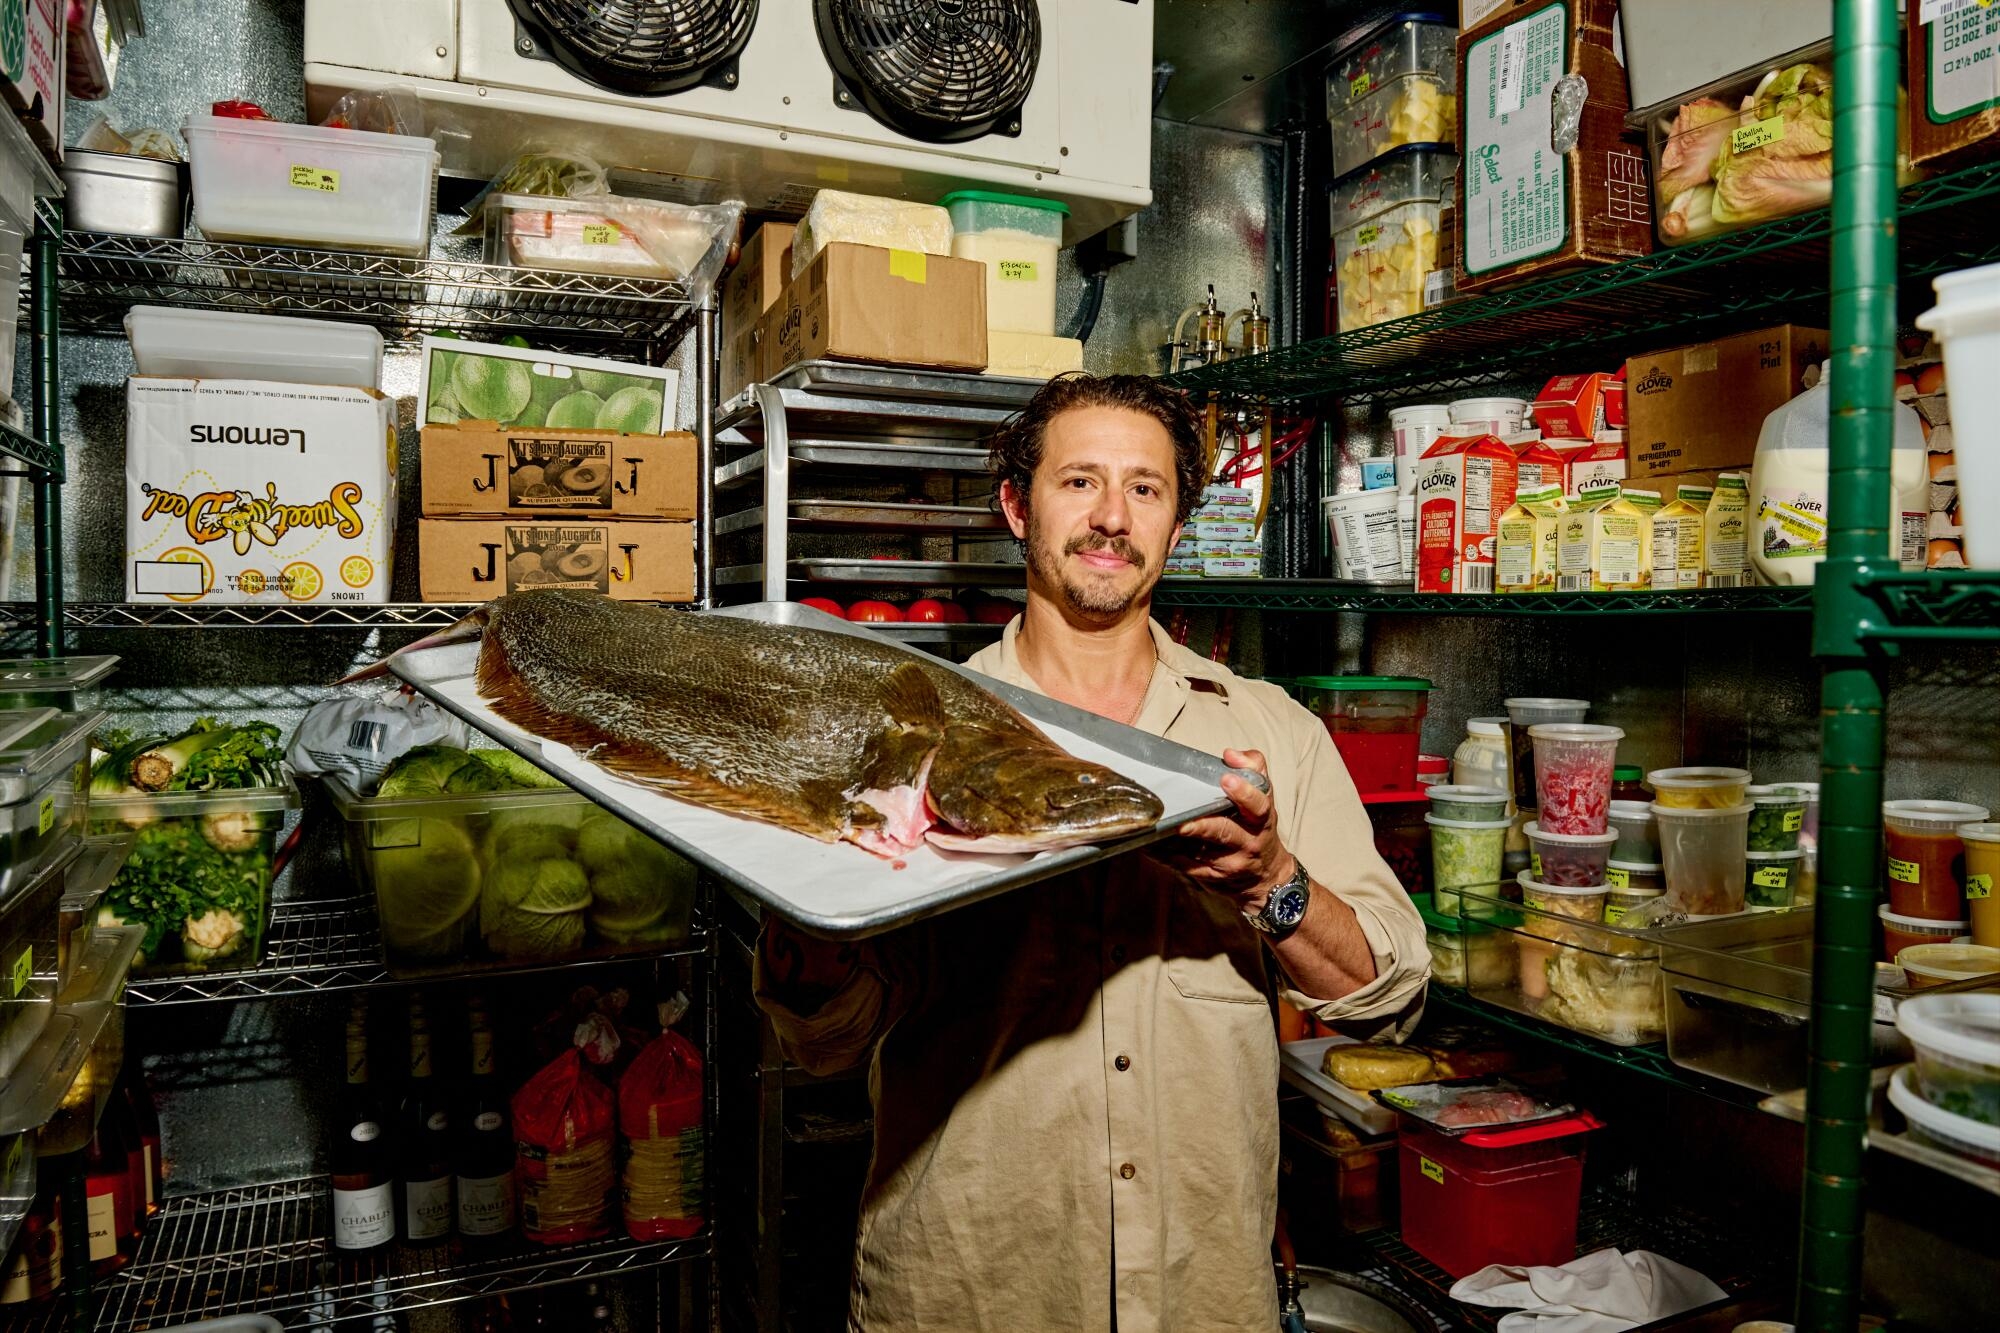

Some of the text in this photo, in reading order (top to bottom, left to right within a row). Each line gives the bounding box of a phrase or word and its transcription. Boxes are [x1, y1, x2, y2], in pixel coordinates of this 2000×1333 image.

[1955, 8, 2000, 32] 1 DOZ. SP
[1543, 33, 1551, 49] DOZ.
[1955, 37, 1960, 47] 2
[1963, 29, 1983, 43] DOZ.
[1974, 47, 1994, 62] DOZ.
[1480, 144, 1503, 184] Select
[1759, 340, 1781, 354] 12-1
[1760, 356, 1781, 369] Pint
[1636, 377, 1673, 394] CLOVER
[190, 424, 305, 453] Lemons
[559, 444, 606, 457] DAUGHTER
[1651, 442, 1666, 451] KEEP
[1638, 449, 1682, 461] REFRIGERATED
[1421, 474, 1456, 490] CLOVER
[1578, 478, 1621, 494] CLOVE
[144, 482, 363, 545] Sweet Deal
[1794, 501, 1822, 512] OVER
[1426, 519, 1449, 528] CULTURED
[1720, 520, 1742, 528] CLOVER
[556, 530, 602, 544] DAUGHTER
[1424, 528, 1451, 537] BUTTERMILK
[1545, 532, 1558, 541] CLO
[331, 591, 364, 600] LEMONS
